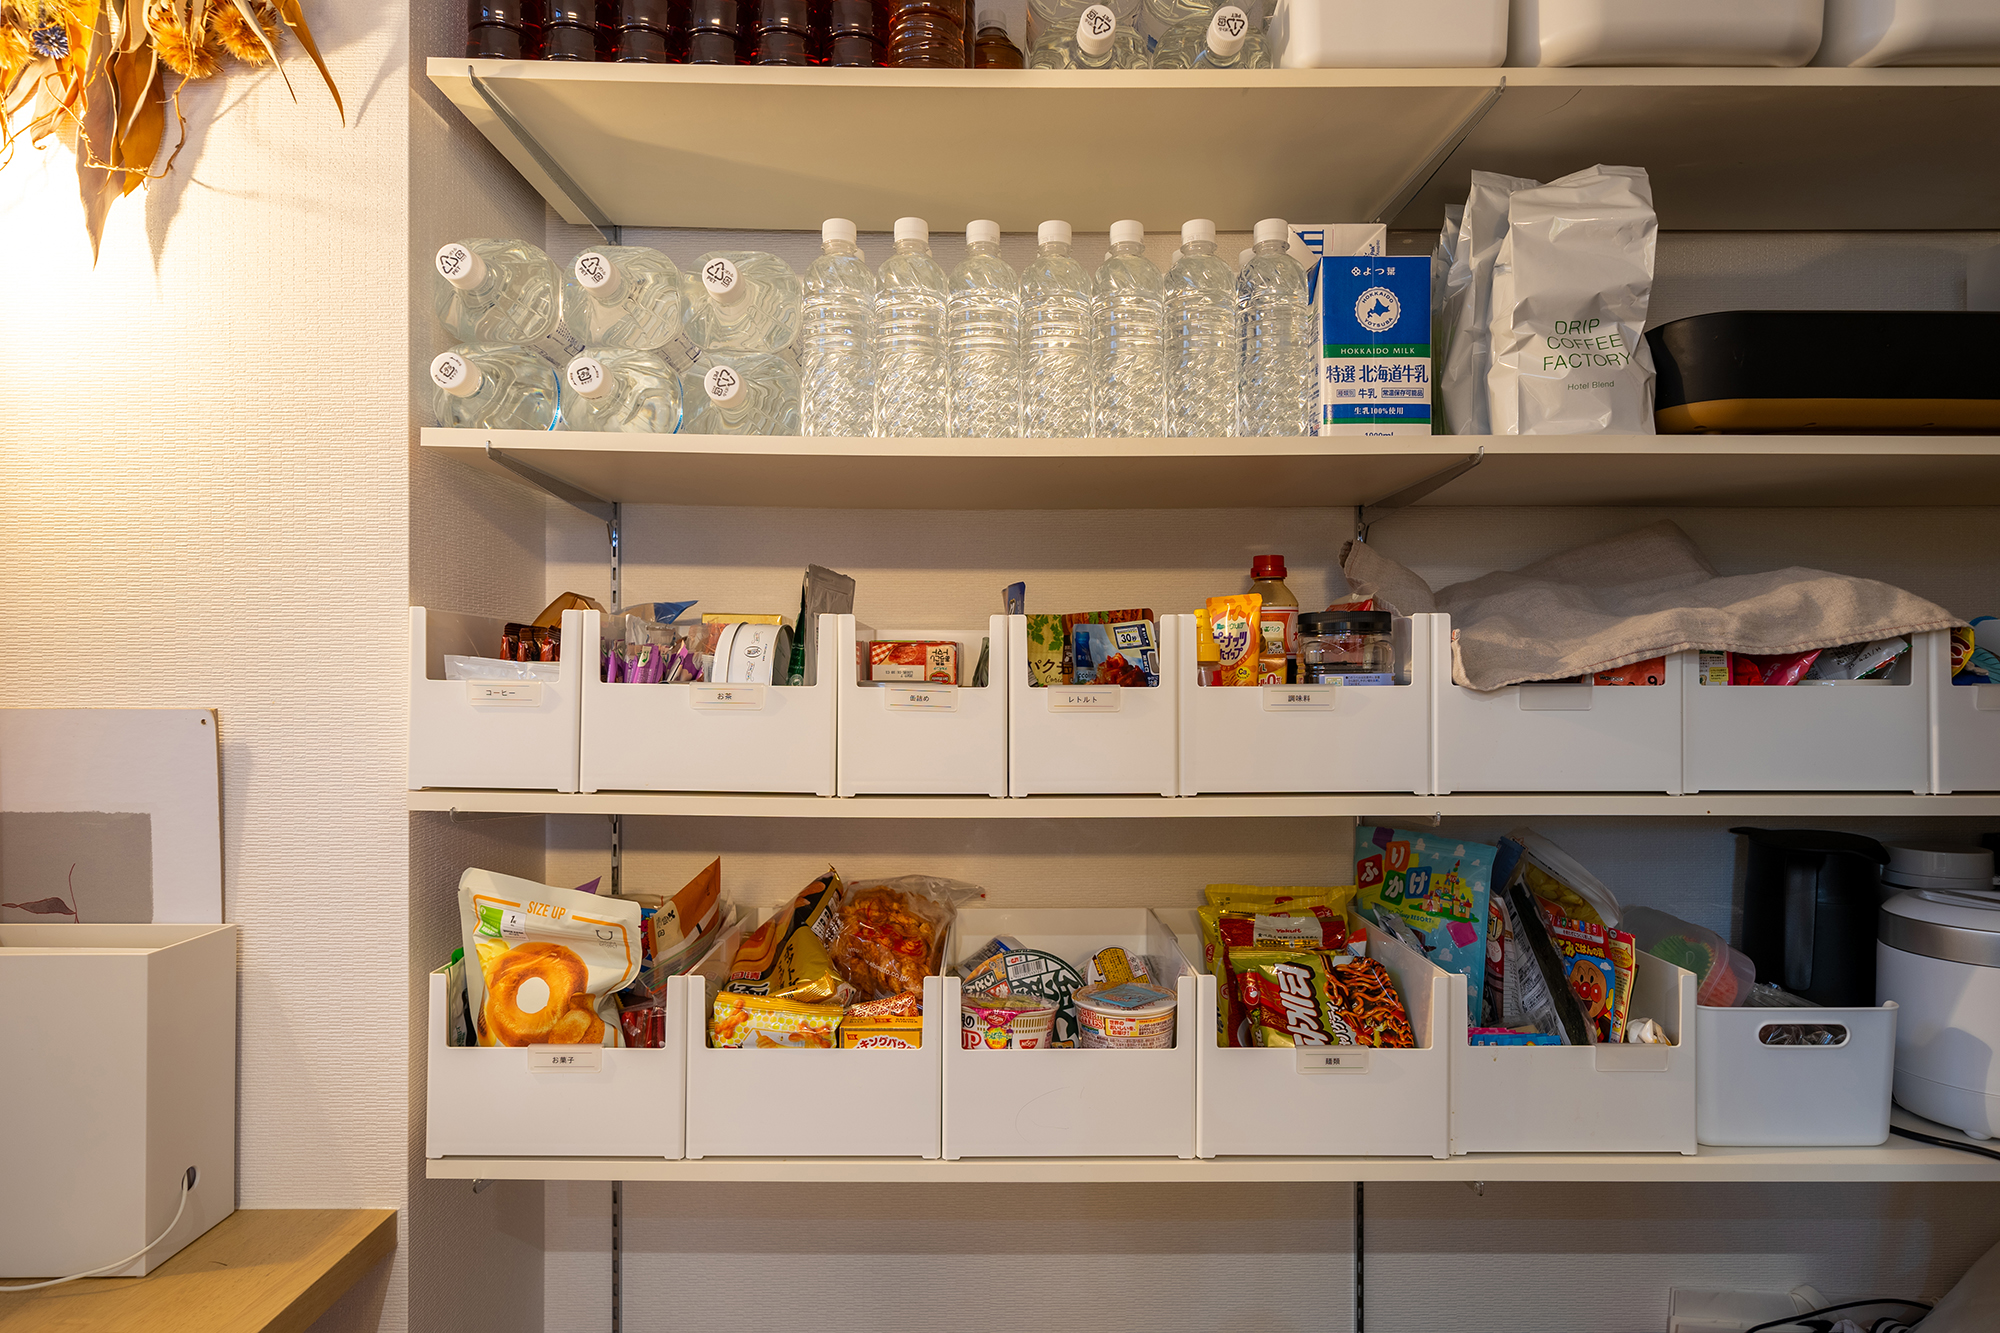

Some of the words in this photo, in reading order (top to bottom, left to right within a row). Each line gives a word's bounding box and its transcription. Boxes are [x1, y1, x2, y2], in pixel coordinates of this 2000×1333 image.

[1363, 266, 1396, 276] よつ葉
[1361, 290, 1394, 304] HOKKAIDO
[1364, 317, 1393, 328] YOTSUBA
[1555, 318, 1600, 335] DRIP
[1547, 333, 1623, 351] COFFEE
[1543, 352, 1631, 371] FACTORY
[1326, 365, 1355, 384] 特選
[1359, 364, 1429, 384] 北海道牛乳
[1567, 382, 1590, 391] Hotel
[1592, 380, 1615, 389] Blend
[1358, 388, 1378, 399] 牛乳
[1354, 407, 1404, 415] 生乳100%使用
[527, 901, 550, 917] SIZE
[551, 907, 566, 920] UP
[1410, 914, 1432, 923] RESORT
[730, 971, 761, 980] 日清
[1081, 1008, 1096, 1017] CUP
